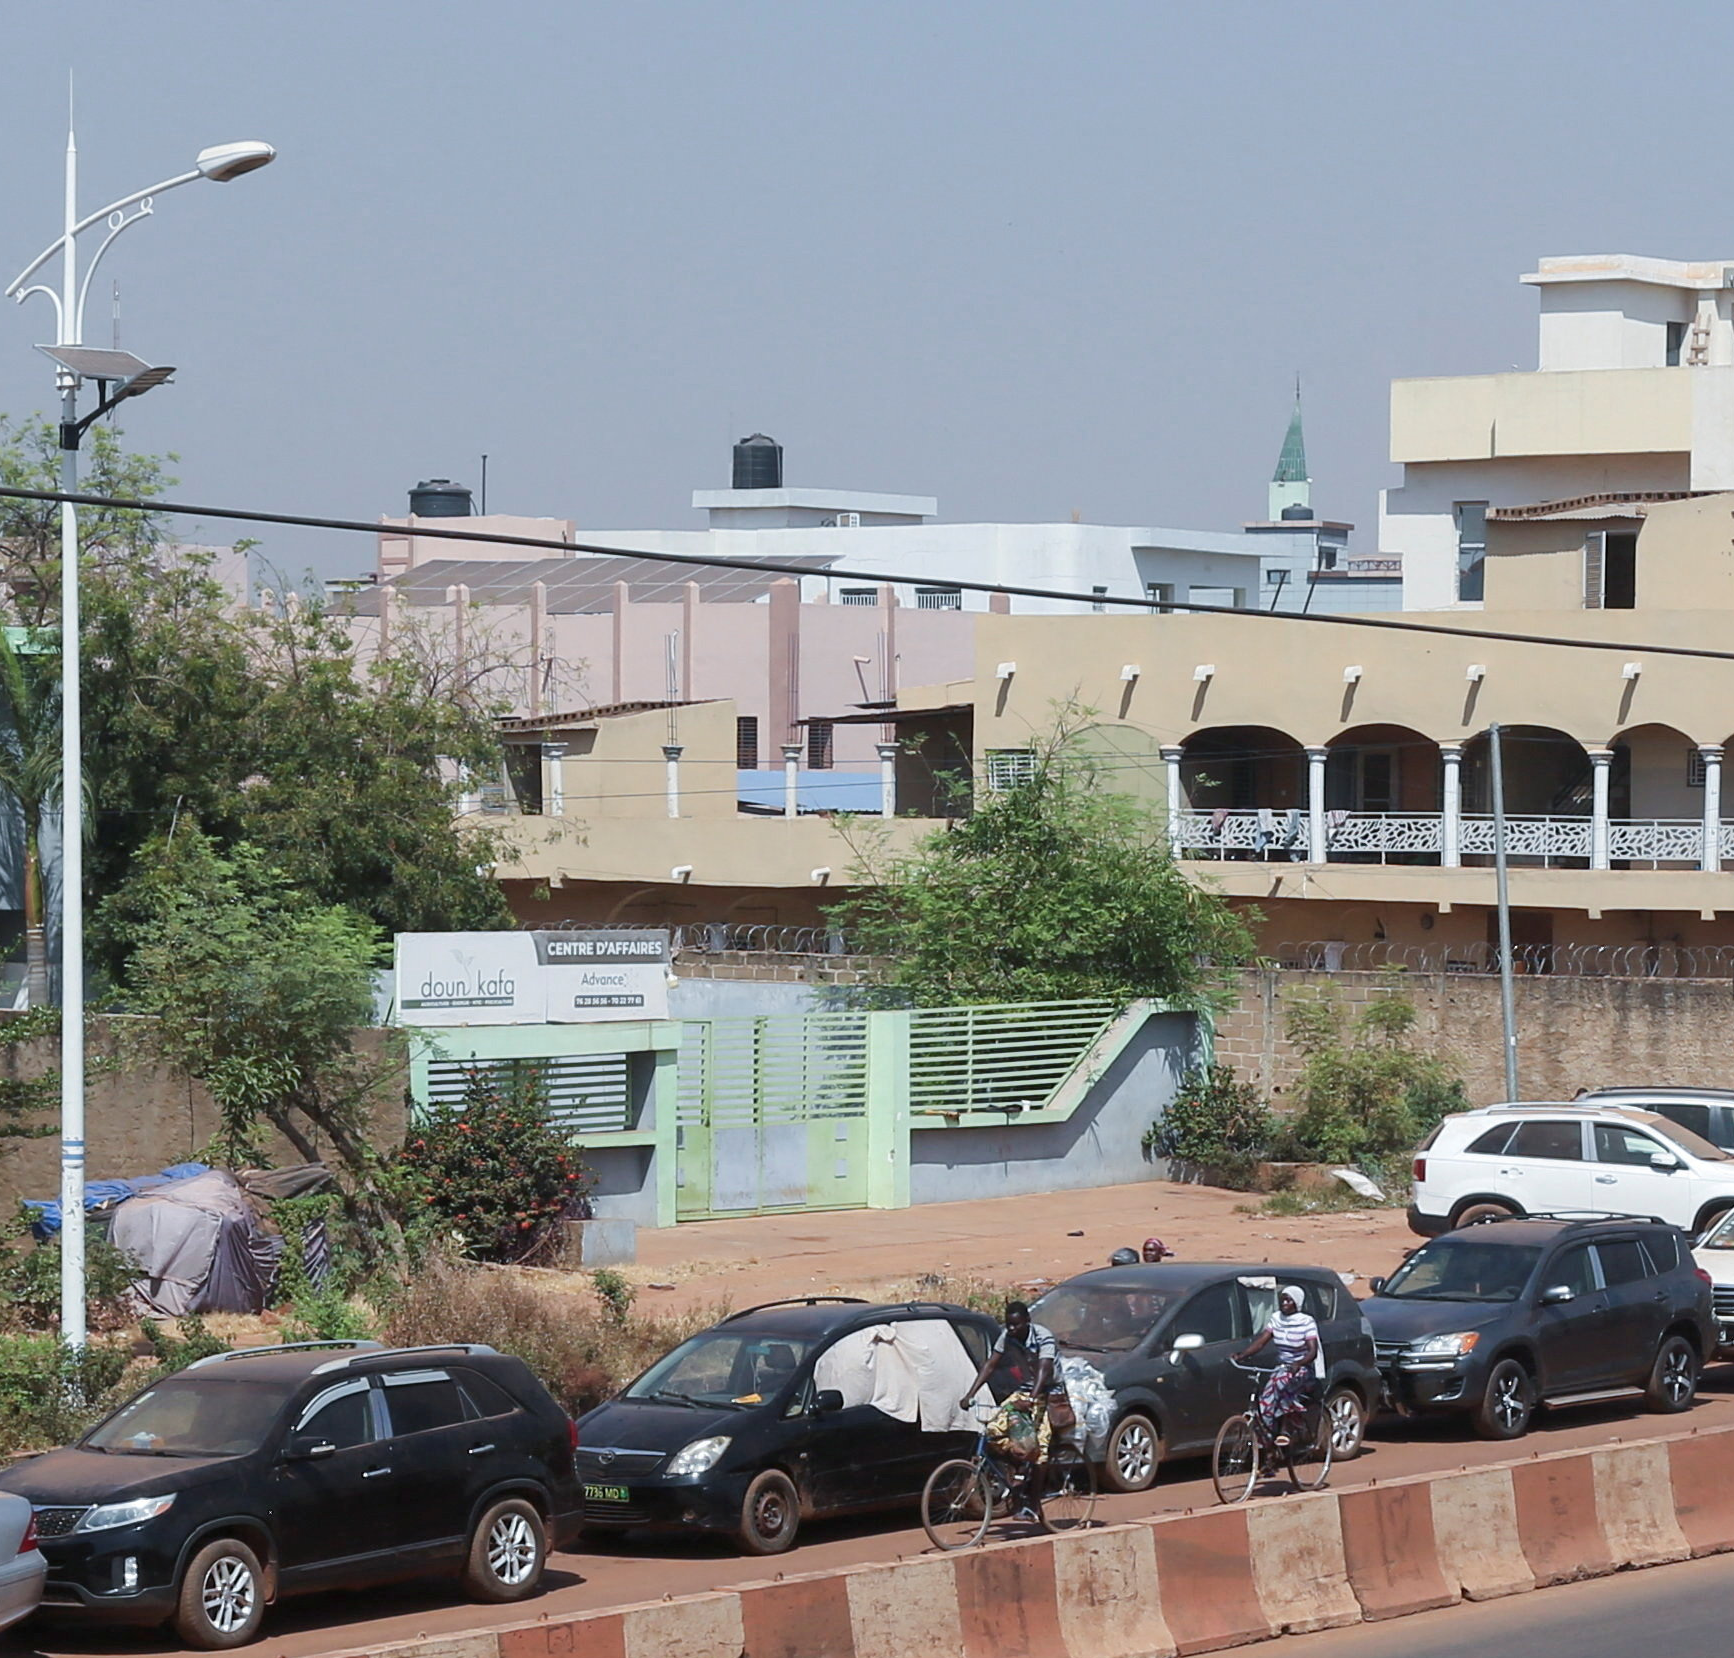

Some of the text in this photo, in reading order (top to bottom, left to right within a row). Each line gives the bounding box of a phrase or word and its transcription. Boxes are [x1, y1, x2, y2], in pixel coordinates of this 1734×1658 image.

[547, 941, 662, 956] CENTRE D'AFFAIRES
[421, 969, 515, 998] doun kafa
[581, 972, 625, 986] Advance
[605, 1487, 619, 1499] MD
